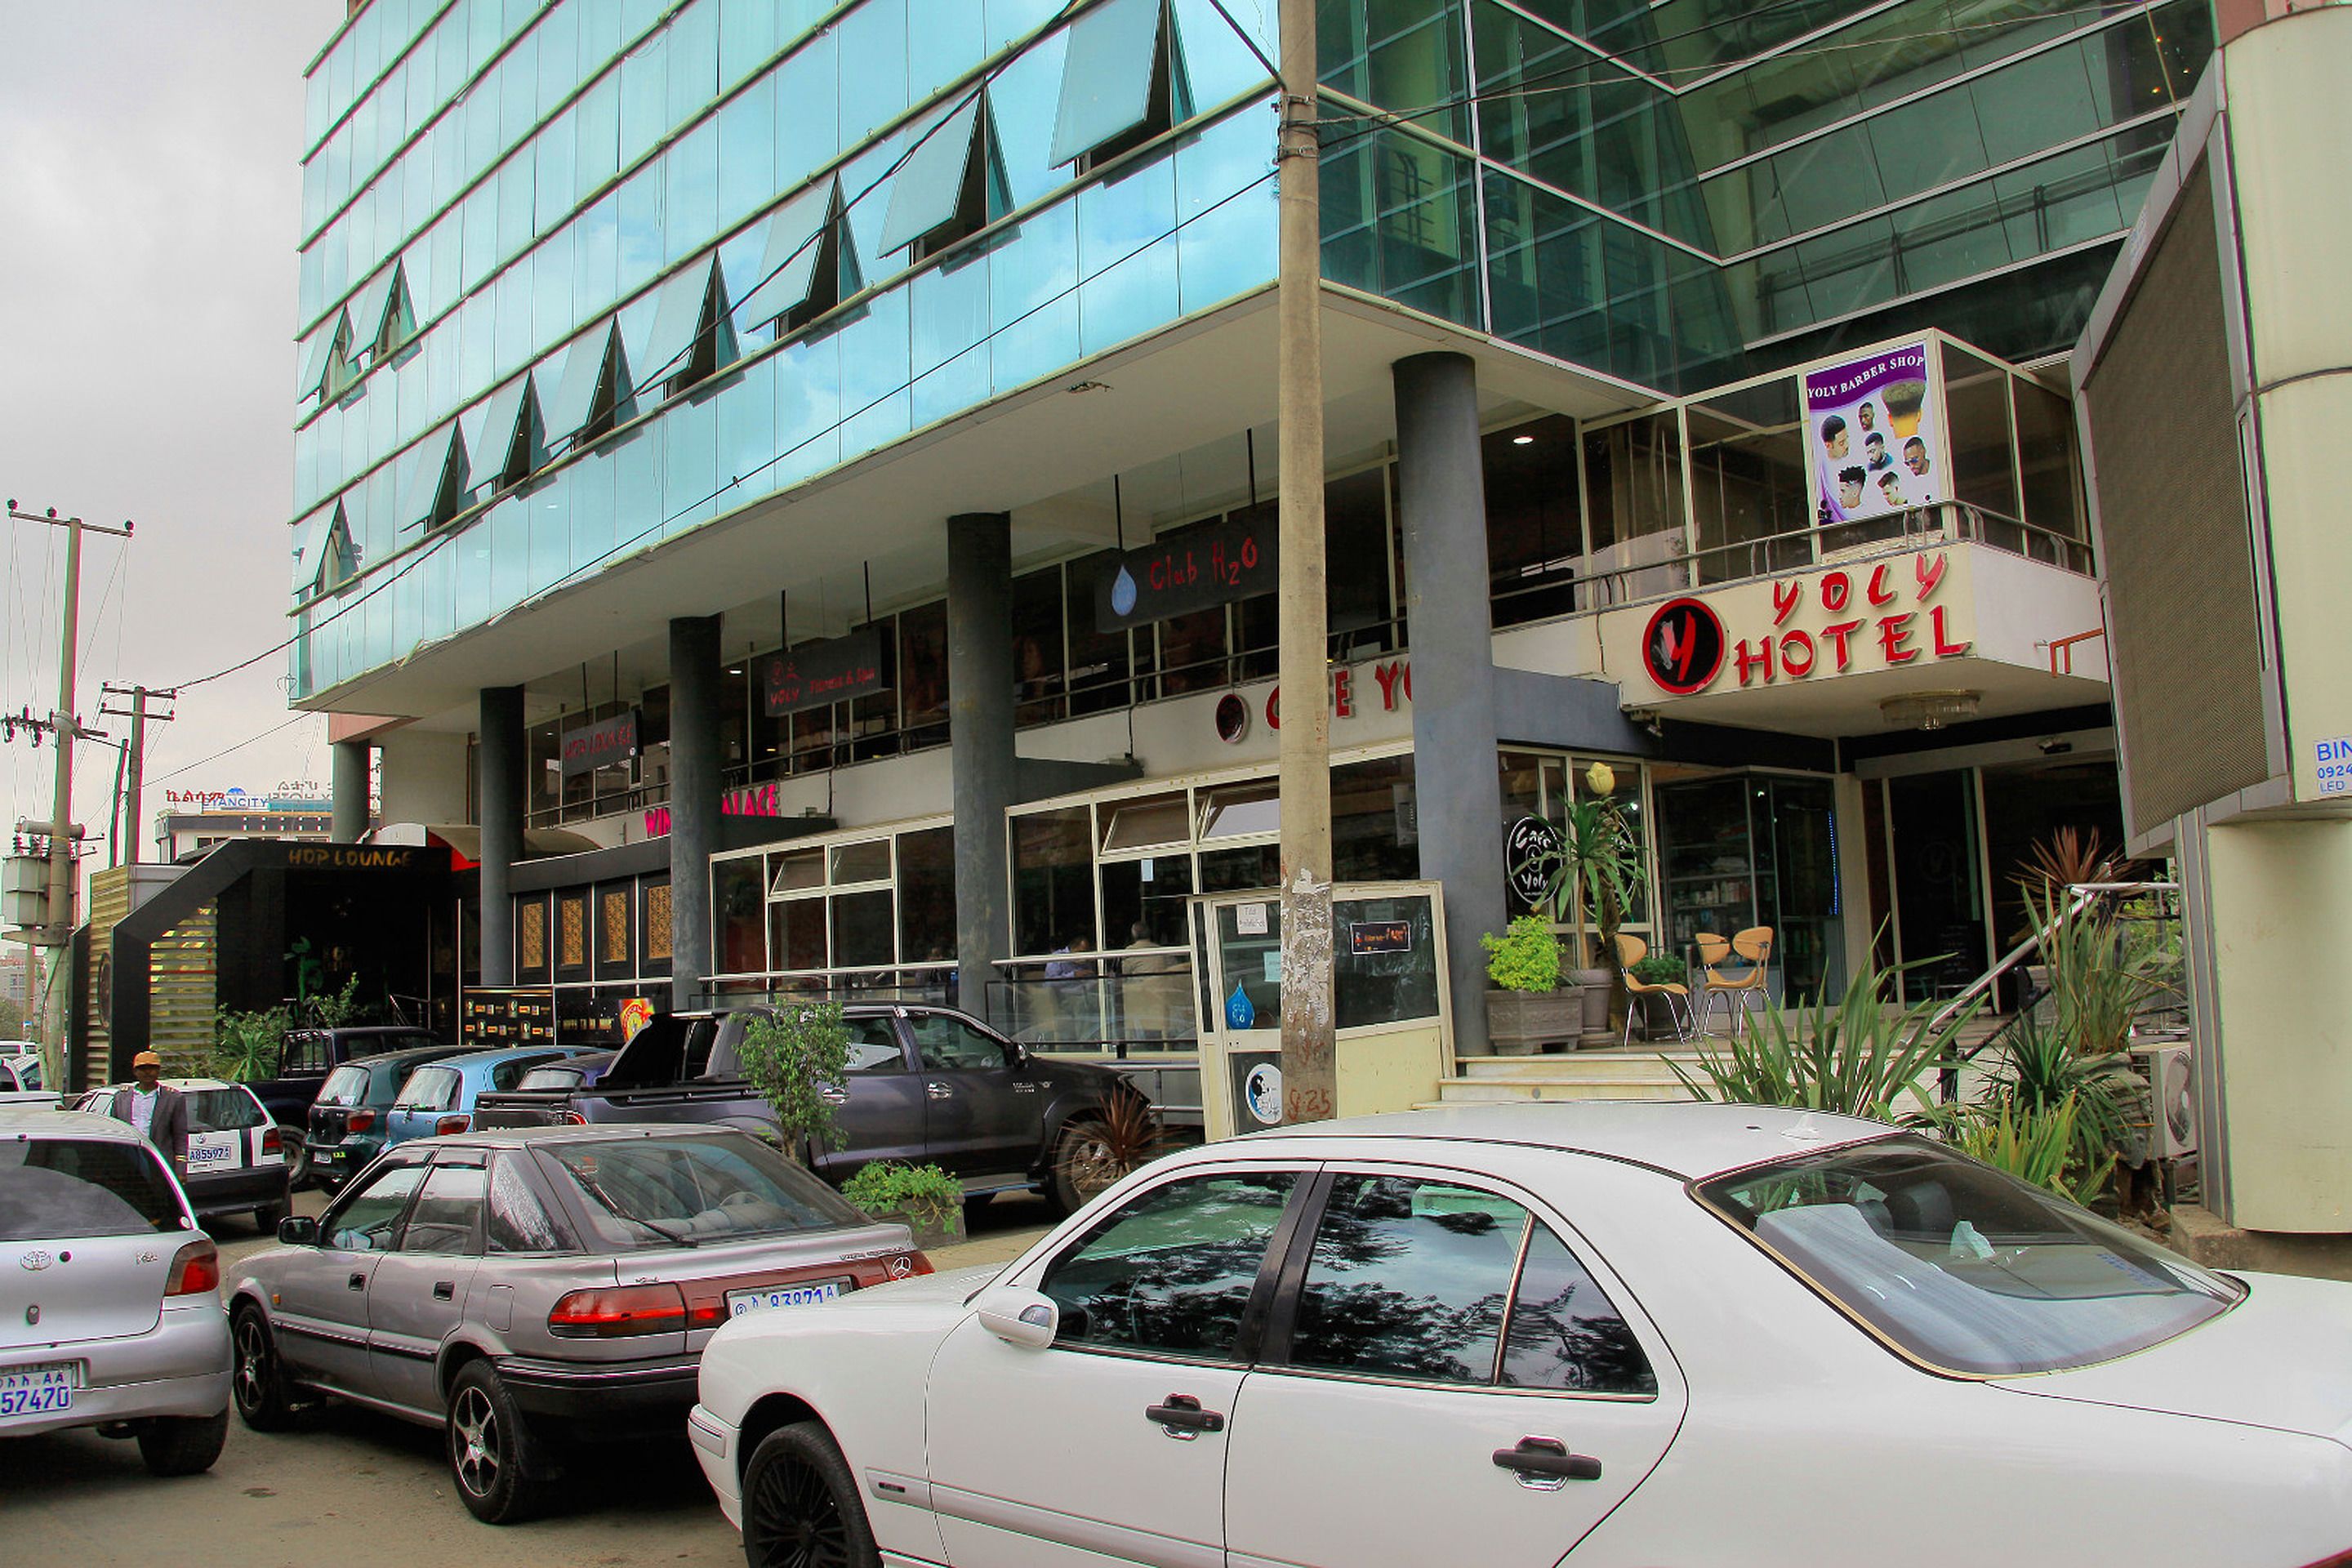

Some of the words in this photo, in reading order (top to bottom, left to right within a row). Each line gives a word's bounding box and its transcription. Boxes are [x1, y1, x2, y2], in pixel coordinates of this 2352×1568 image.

[1807, 384, 1838, 399] YOLY
[1840, 363, 1886, 394] BARBER
[1889, 354, 1925, 370] SHOP
[1149, 551, 1199, 590] Club
[1773, 552, 1949, 627] YOLY
[1733, 604, 1974, 688] HOTEL
[2319, 780, 2345, 792] LED
[288, 848, 329, 865] HOP
[333, 850, 412, 866] LOUNGE
[1, 1386, 70, 1414] 57470
